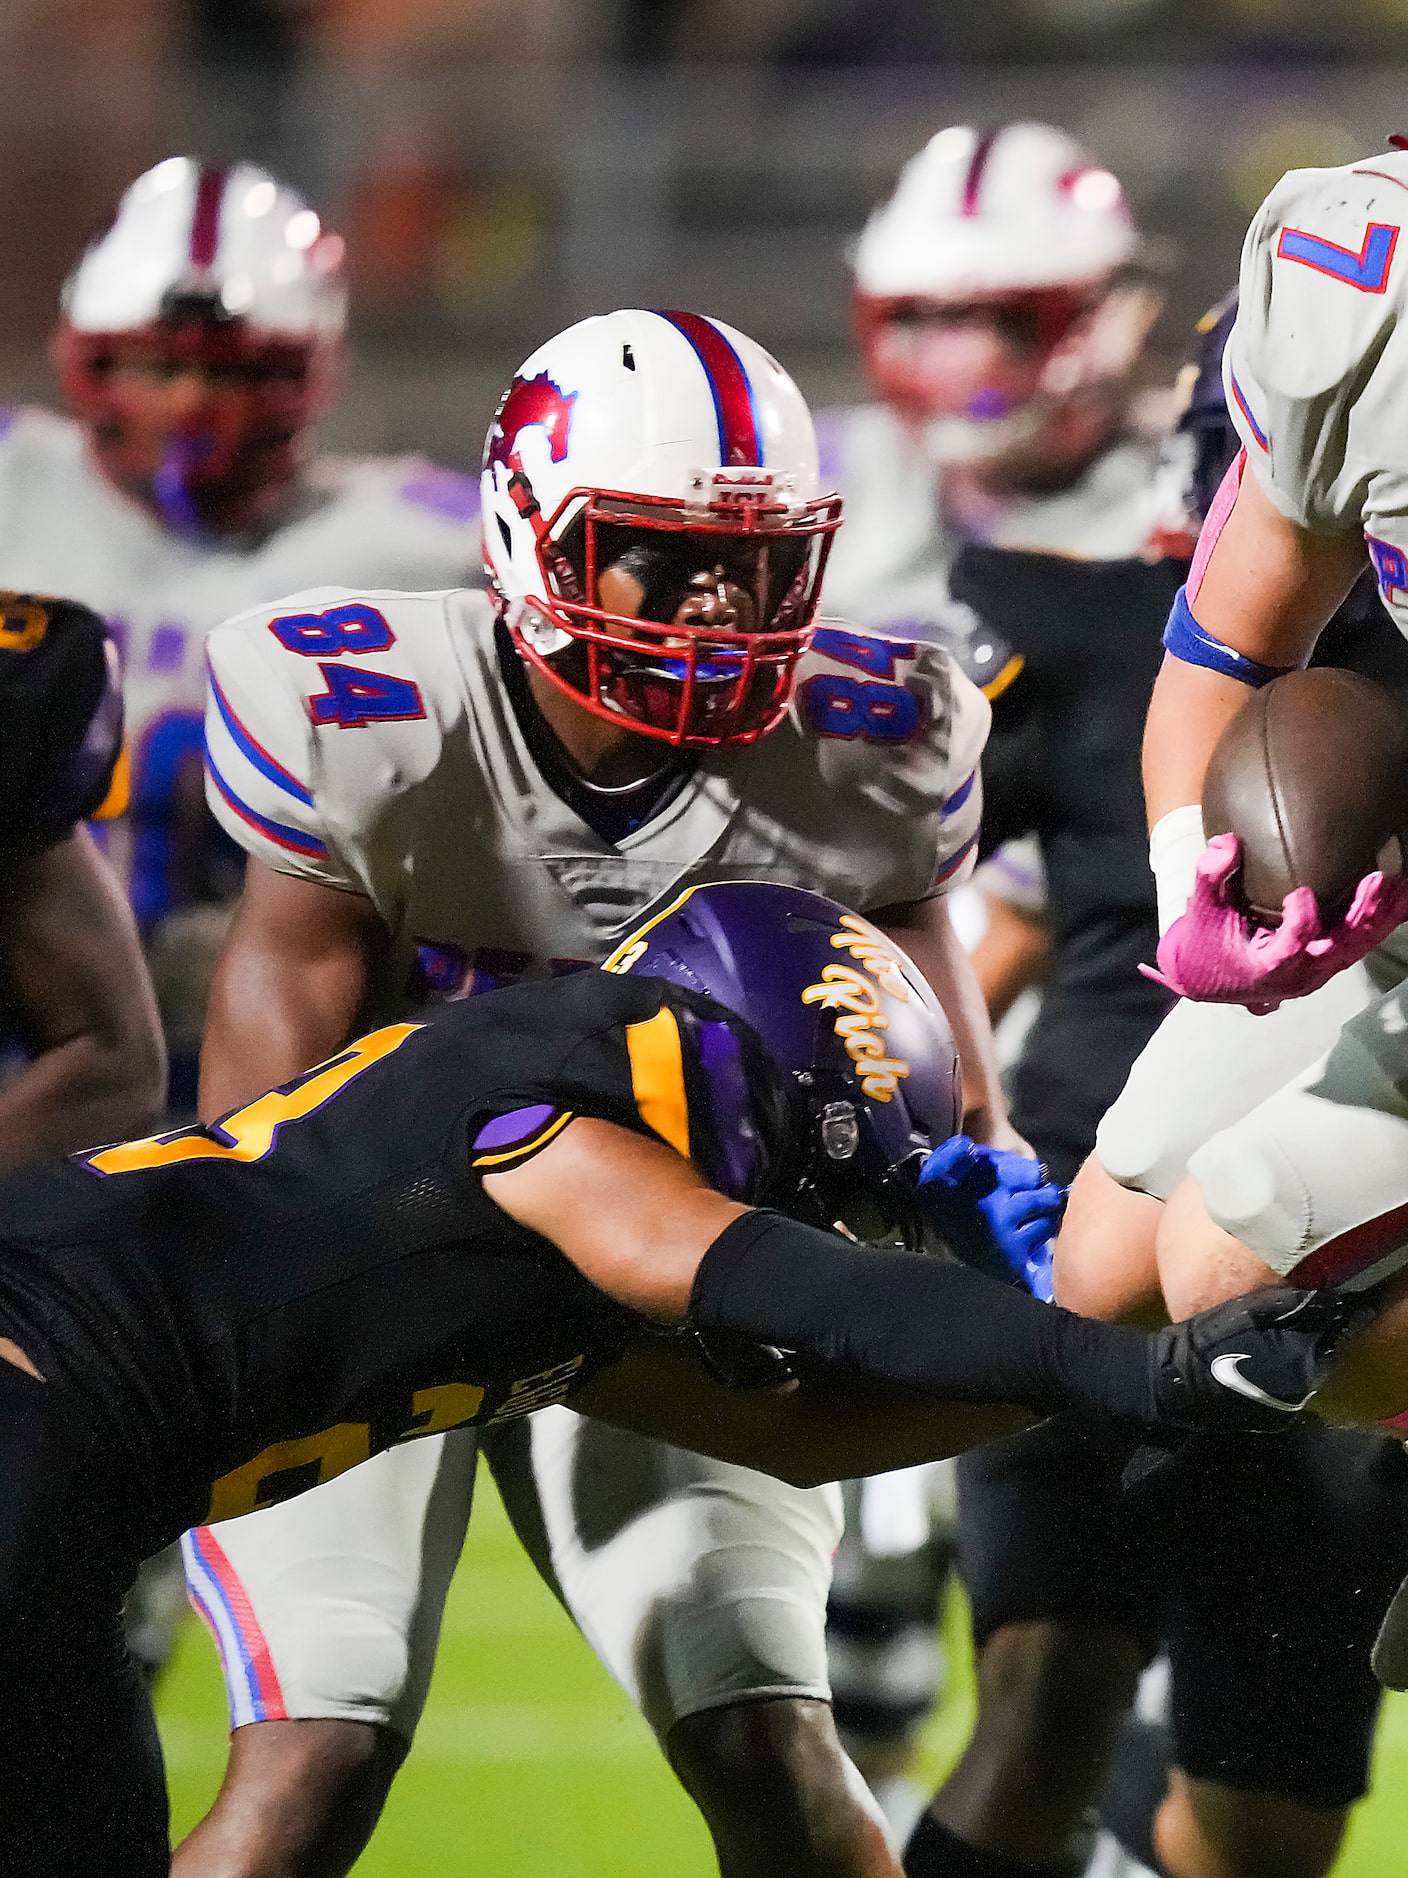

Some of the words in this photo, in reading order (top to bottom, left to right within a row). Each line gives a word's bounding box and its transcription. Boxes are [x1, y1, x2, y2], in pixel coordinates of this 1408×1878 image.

[1277, 222, 1400, 294] 7
[267, 603, 428, 730] 84
[801, 627, 917, 745] 84
[801, 963, 910, 1103] Rich
